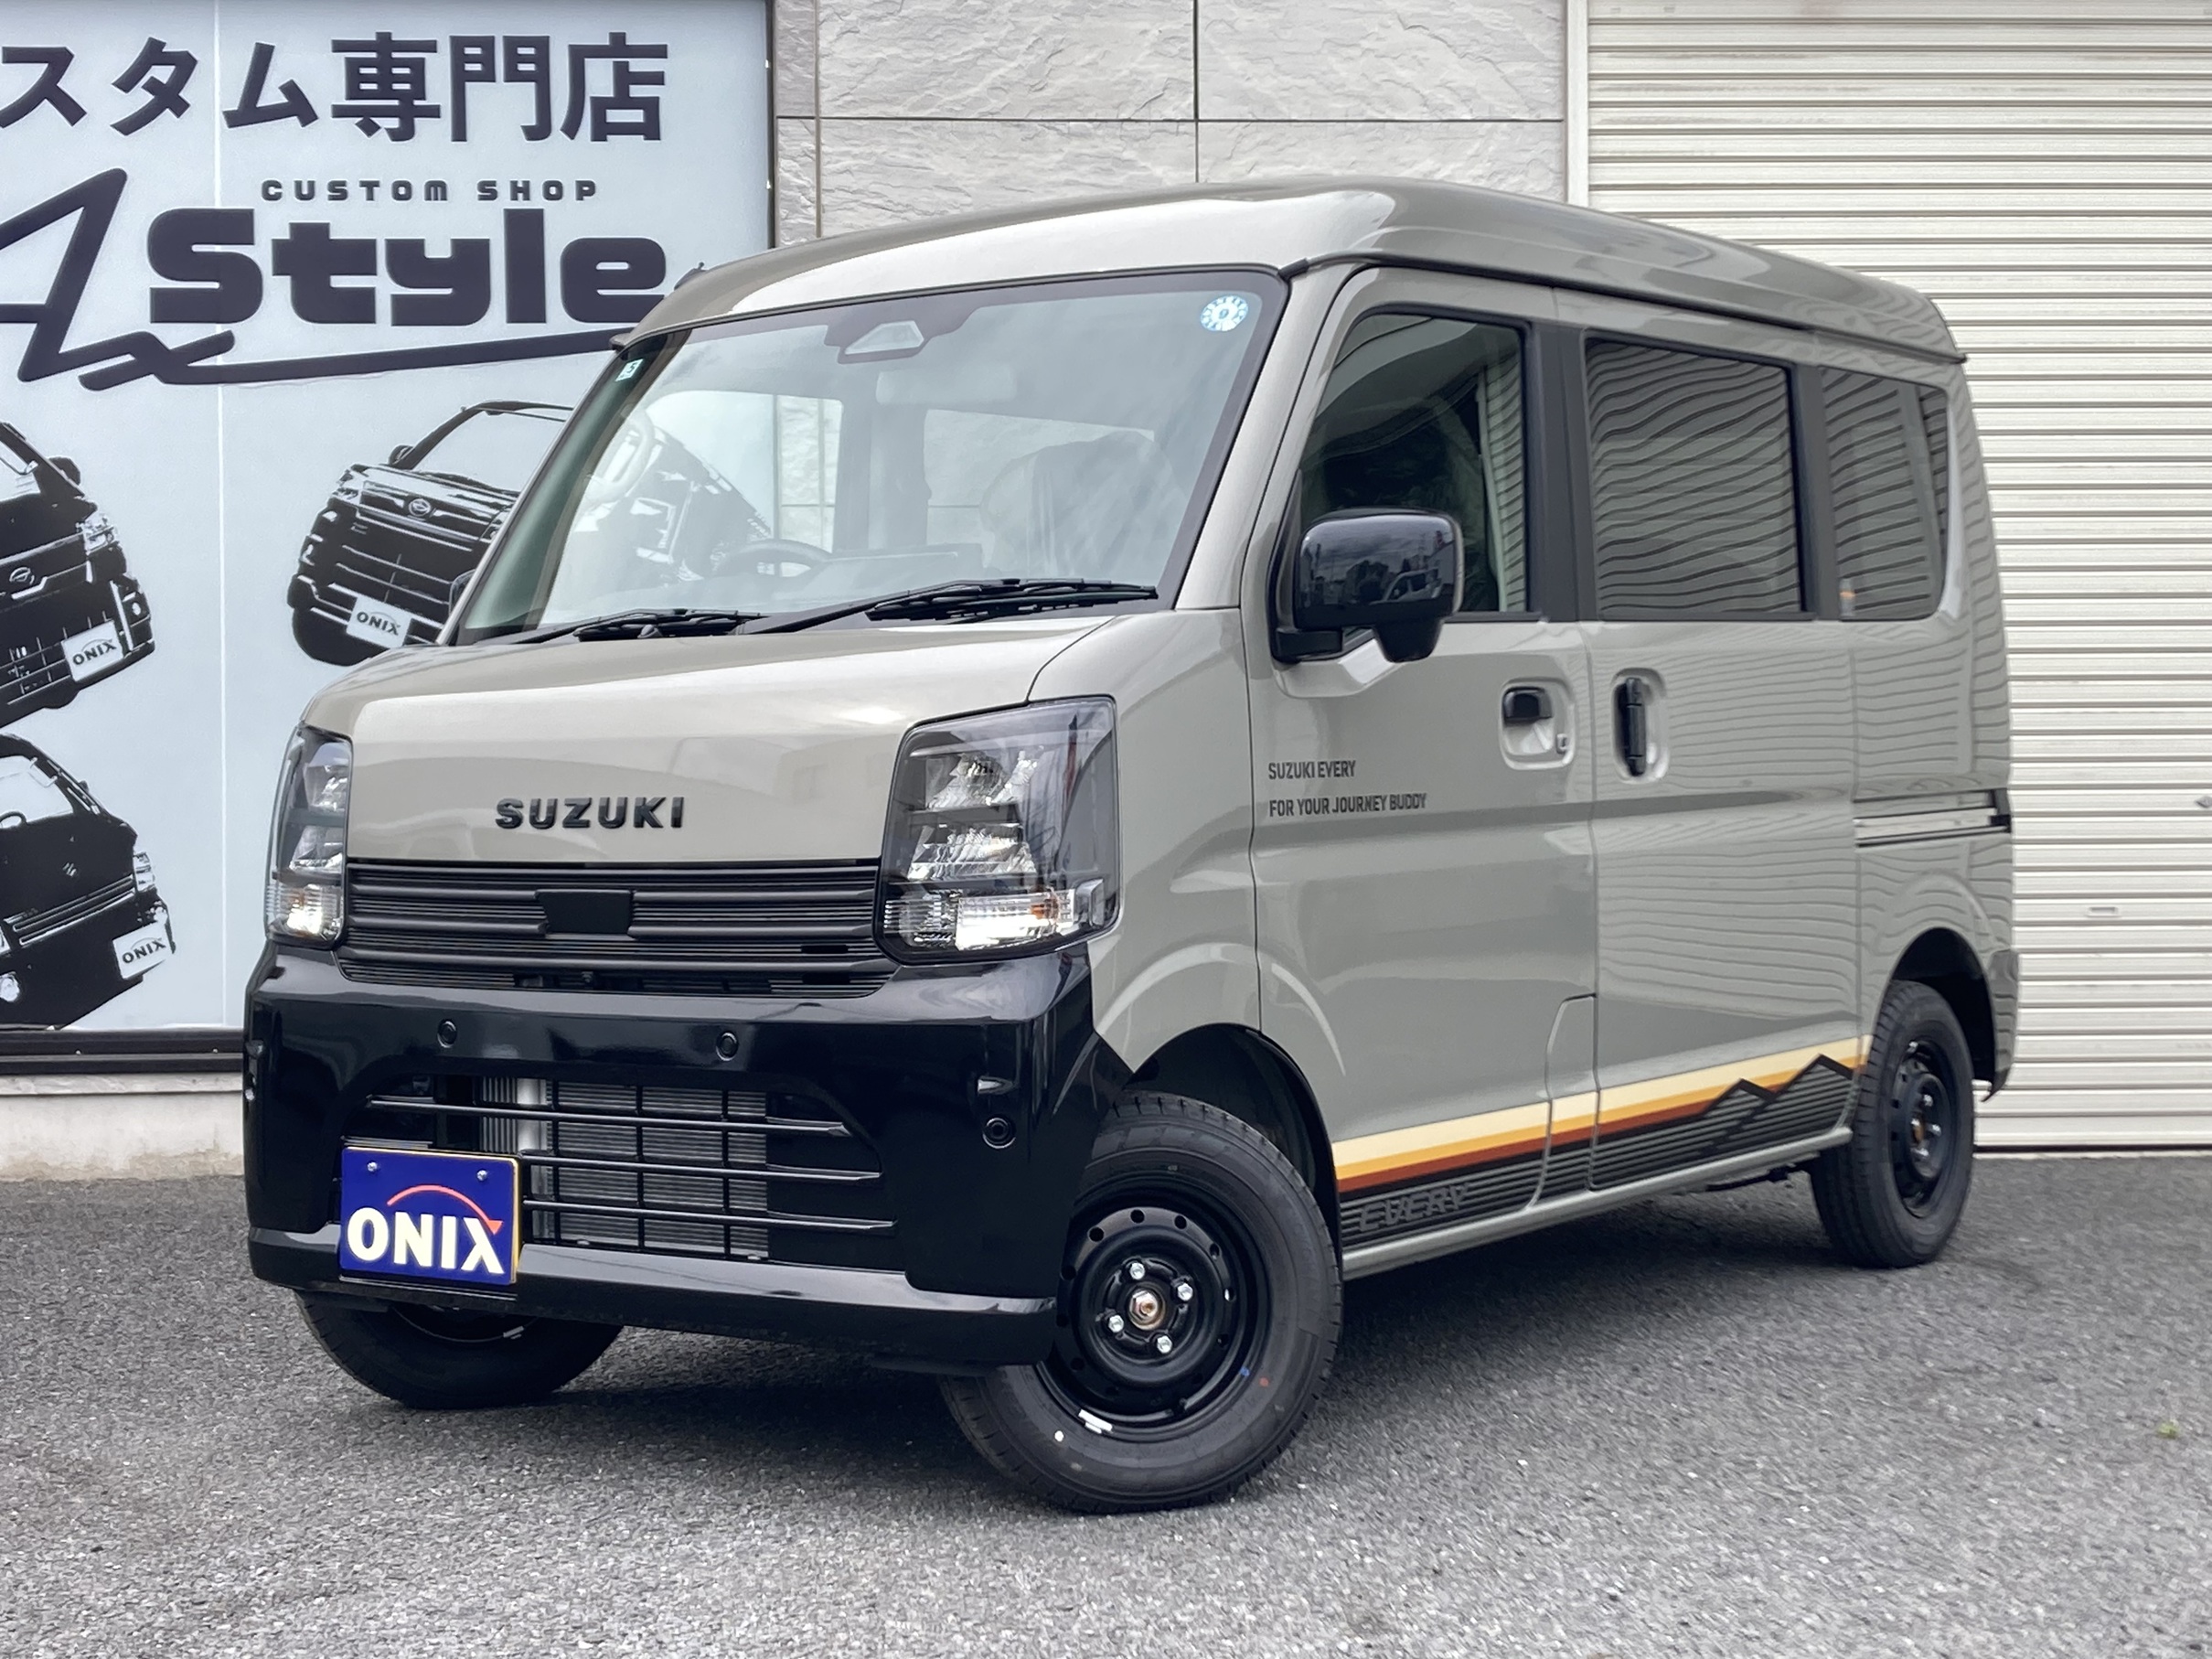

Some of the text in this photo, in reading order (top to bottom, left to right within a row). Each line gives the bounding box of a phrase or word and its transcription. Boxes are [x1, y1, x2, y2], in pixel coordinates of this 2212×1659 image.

[0, 32, 668, 143] スタム専門店
[262, 179, 596, 201] CUSTOM SHOP
[357, 611, 399, 636] ONIX
[72, 641, 117, 665] ONIX
[1268, 760, 1356, 779] SUZUKI EVERY
[495, 797, 685, 830] SUZUKI
[1269, 793, 1427, 817] FOR YOUR JOURNEY BUDDY
[122, 940, 166, 963] ONIX
[1359, 1182, 1471, 1232] EVERY
[347, 1207, 505, 1274] ONIX
